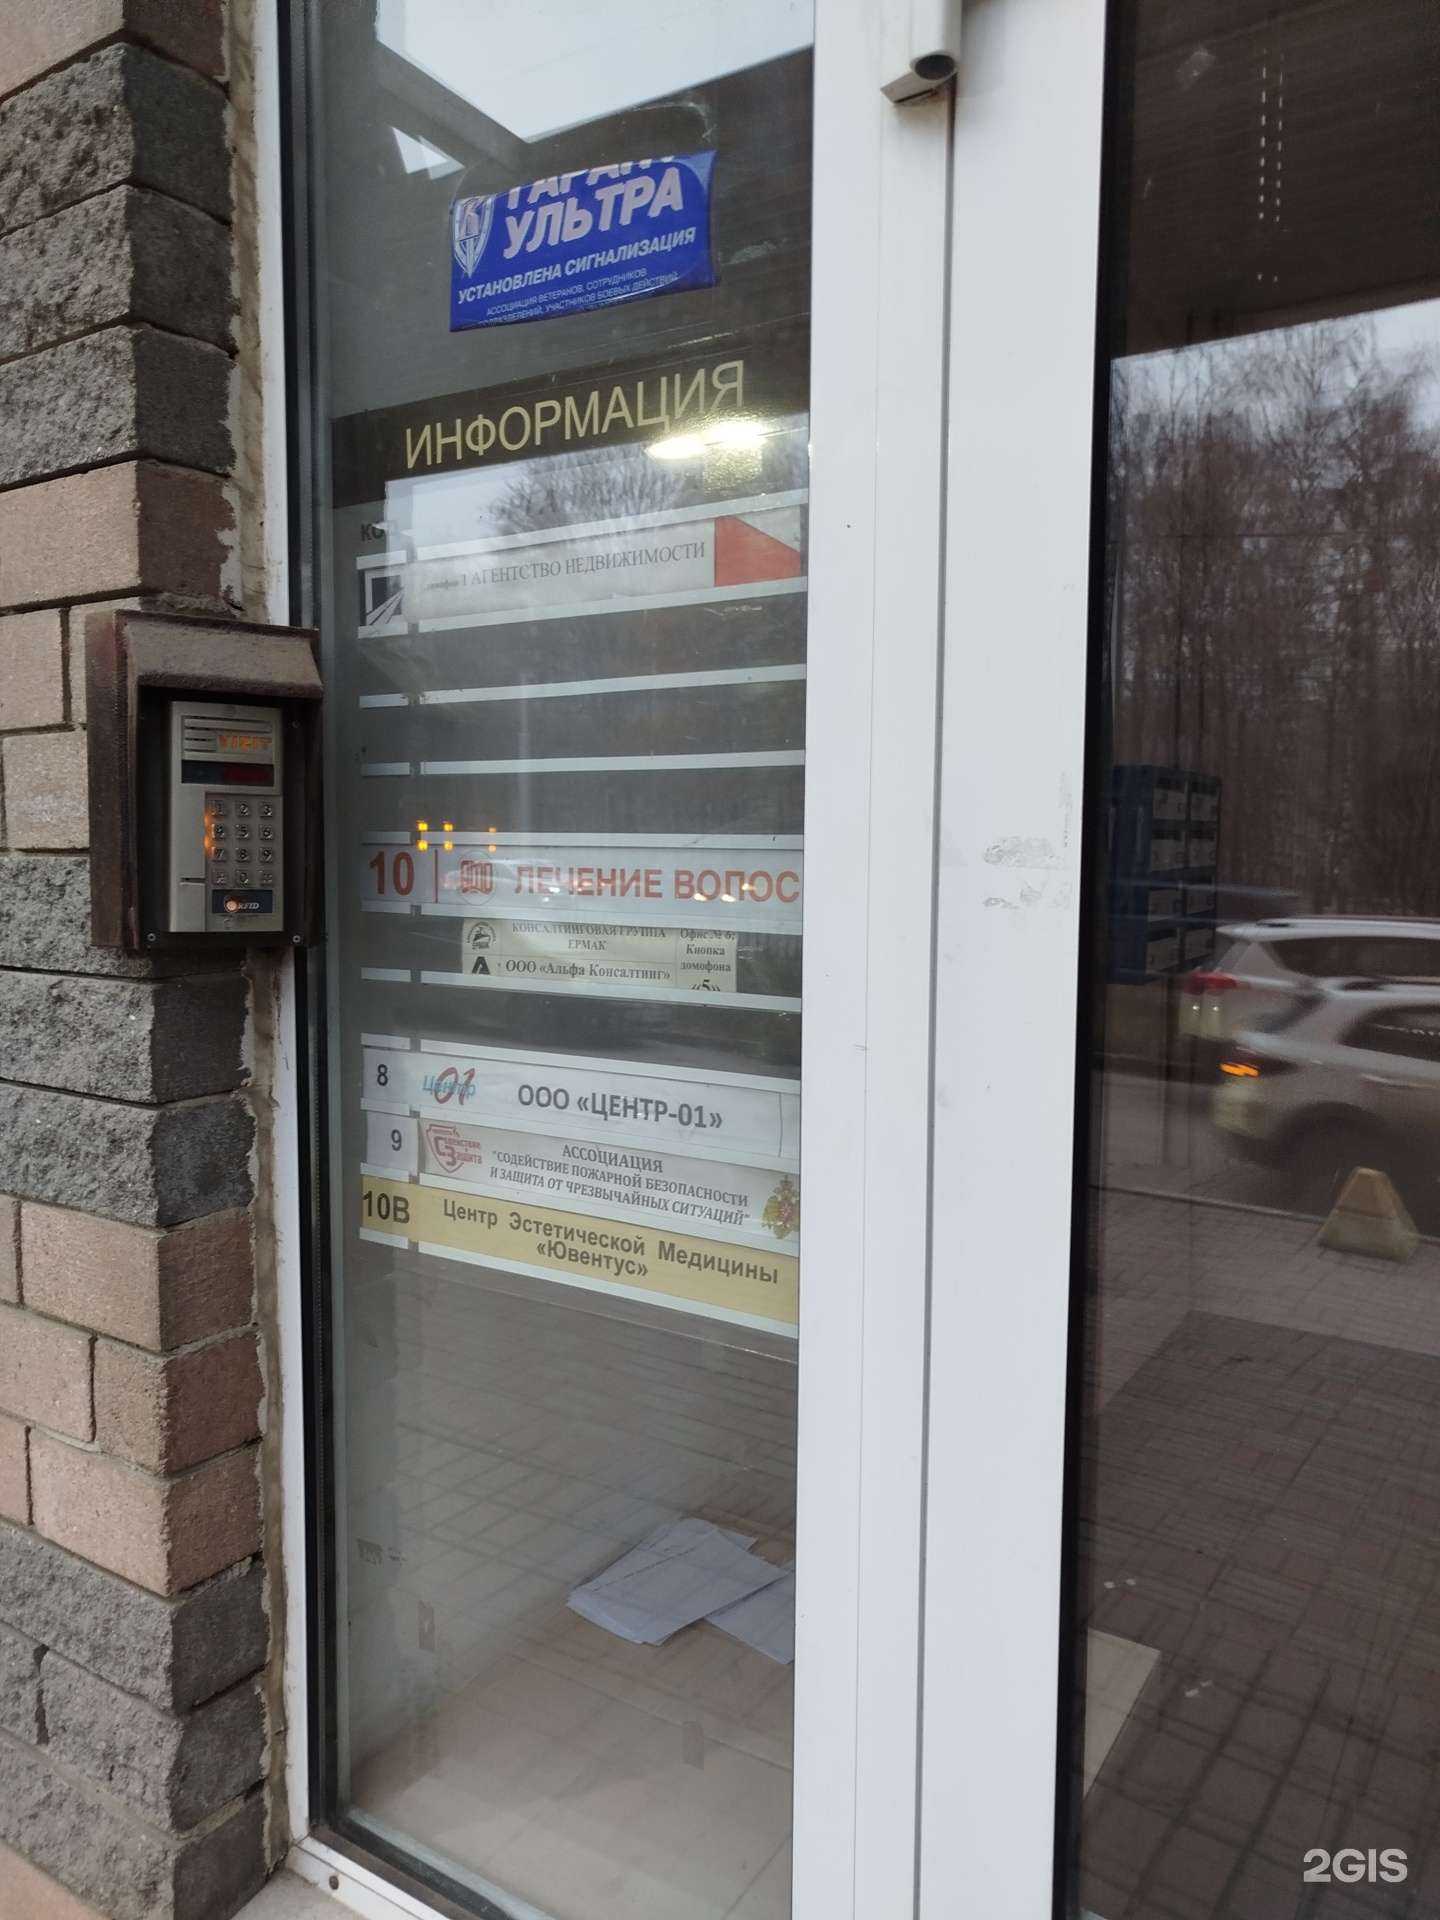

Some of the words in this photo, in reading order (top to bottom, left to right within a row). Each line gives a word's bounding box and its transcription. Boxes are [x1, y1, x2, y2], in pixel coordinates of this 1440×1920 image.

[503, 167, 684, 259] УЛЬТРА
[458, 262, 562, 304] УСТАНОВЛЕНА
[564, 227, 697, 275] СИГНАЛИЗАЦИЯ
[405, 360, 744, 469] ИНФОРМАЦИЯ
[471, 560, 561, 586] АГЕНТСТВО
[565, 542, 705, 575] НЕДВИЖИМОСТИ
[368, 851, 415, 896] 10
[515, 866, 663, 899] ЛЕЧЕНИЕ
[568, 939, 608, 951] ЕРМАК
[680, 928, 709, 941] Офис
[686, 944, 725, 956] Кнопка
[506, 959, 536, 973] ООО
[539, 962, 585, 979] «Альфа
[589, 964, 671, 981] Консалтинг»
[681, 960, 732, 974] домофона
[377, 1063, 388, 1086] 8
[518, 1084, 570, 1110] ООО
[577, 1091, 723, 1130] «ЦЕНТР-01»
[391, 1129, 402, 1152] 9
[562, 1144, 664, 1173] АССОЦИАЦИЯ
[489, 1166, 498, 1179] И
[499, 1168, 545, 1188] ЗАЩИТА
[547, 1177, 563, 1190] ОТ
[566, 1180, 669, 1212] ЧРЕЗВЫЧАЙНЫХ
[672, 1200, 750, 1226] СИТУАЦИЙ"
[492, 1150, 569, 1175] "СОДЕЙСТВИЕ
[572, 1164, 642, 1188] ПОЖАРНОЙ
[645, 1178, 749, 1207] БЕЗОПАСНОСТИ
[363, 1190, 410, 1225] 10В
[443, 1199, 498, 1231] Центр
[509, 1211, 645, 1257] Эстетической
[658, 1241, 778, 1284] Медицины
[537, 1240, 649, 1277] «Ювентус»
